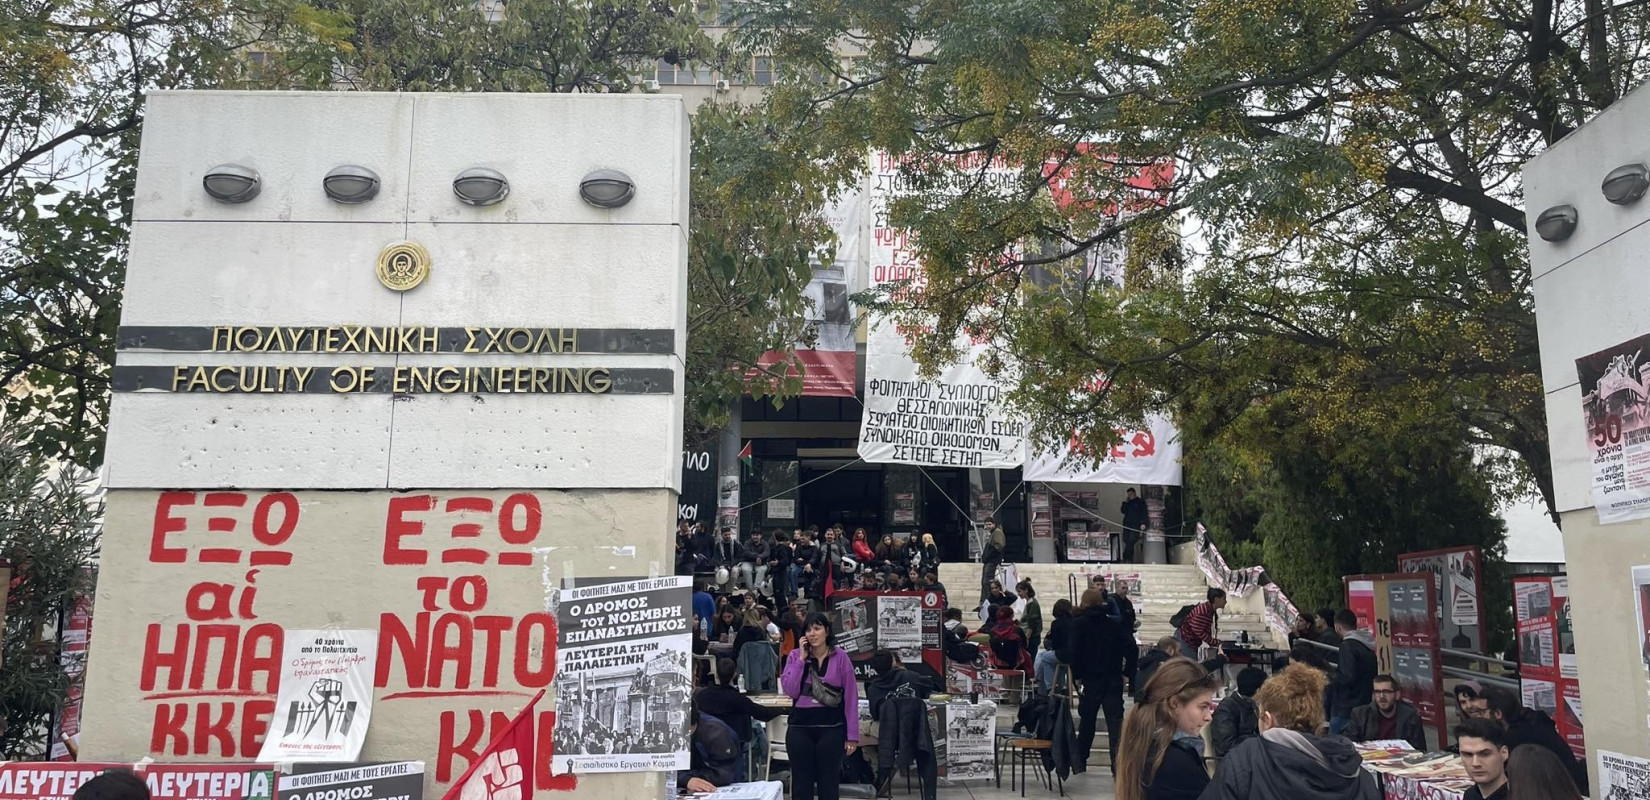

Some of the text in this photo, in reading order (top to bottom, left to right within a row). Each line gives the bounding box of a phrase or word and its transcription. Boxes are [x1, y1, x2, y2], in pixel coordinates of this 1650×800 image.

[213, 326, 577, 353] ΠΟΛΥΤΕΧΝΙΚΗ ΣΧΟΛΗ
[172, 366, 611, 393] FACULTY OF ENGINEERING
[870, 378, 931, 399] ΦΟΙΤΗΤΙΚΟΙ
[938, 383, 1000, 404] ΣΥΛΛΟΓΟΙ
[897, 397, 987, 419] ΘΕΣΣΑΛΟΝΙΚΗΣ
[867, 409, 918, 429] ΣΩΜΑΤΕΙΟ
[921, 415, 989, 435] ΔΙΟΙΚΗΤΙΚΩΝ,
[1594, 414, 1621, 447] 50
[863, 428, 928, 446] ΣΥΝΔΙΚΑΤΟ
[1597, 444, 1622, 459] χρόνια
[149, 492, 299, 566] ΕΞΩ
[383, 493, 542, 566] ΕΞΩ
[417, 575, 488, 612] το
[572, 577, 678, 599] ΟΙ ΦΟΙΤΗΤΕΣ ΜΑΖΙ ΜΕ ΤΟΥΣ ΕΡΓΑΤΕΣ
[570, 596, 648, 617] Ο ΔΡΟΜΟΣ
[580, 605, 682, 628] ΤΟΥ ΝΟΕΜΒΡΗ
[325, 638, 344, 646] χρόνια
[565, 618, 687, 643] ΕΠΑΝΑΣΤΑΤΙΚΟΣ
[140, 623, 285, 691] ΗΠΑ
[373, 611, 558, 689] ΝΑΤΟ
[564, 653, 645, 672] ΠΑΛΑΙΣΤΙΝΗ
[565, 642, 659, 661] ΛΕΥΤΕΡΙΑ ΣΤΗΝ
[151, 702, 276, 757] ΚΚΕ
[292, 764, 408, 787] ΟΙ ΦΟΙΤΗΤΕΣ ΜΑΖΙ ΜΕ ΤΟΥΣ ΕΡΓΑΤΕΣ
[574, 760, 676, 770] Σοσιαλιστικό Εργατικό Κόμμα
[0, 770, 104, 795] ΛΕΥΤΕΡ
[146, 772, 268, 797] ΛΕΥΤΕΡΙΑ
